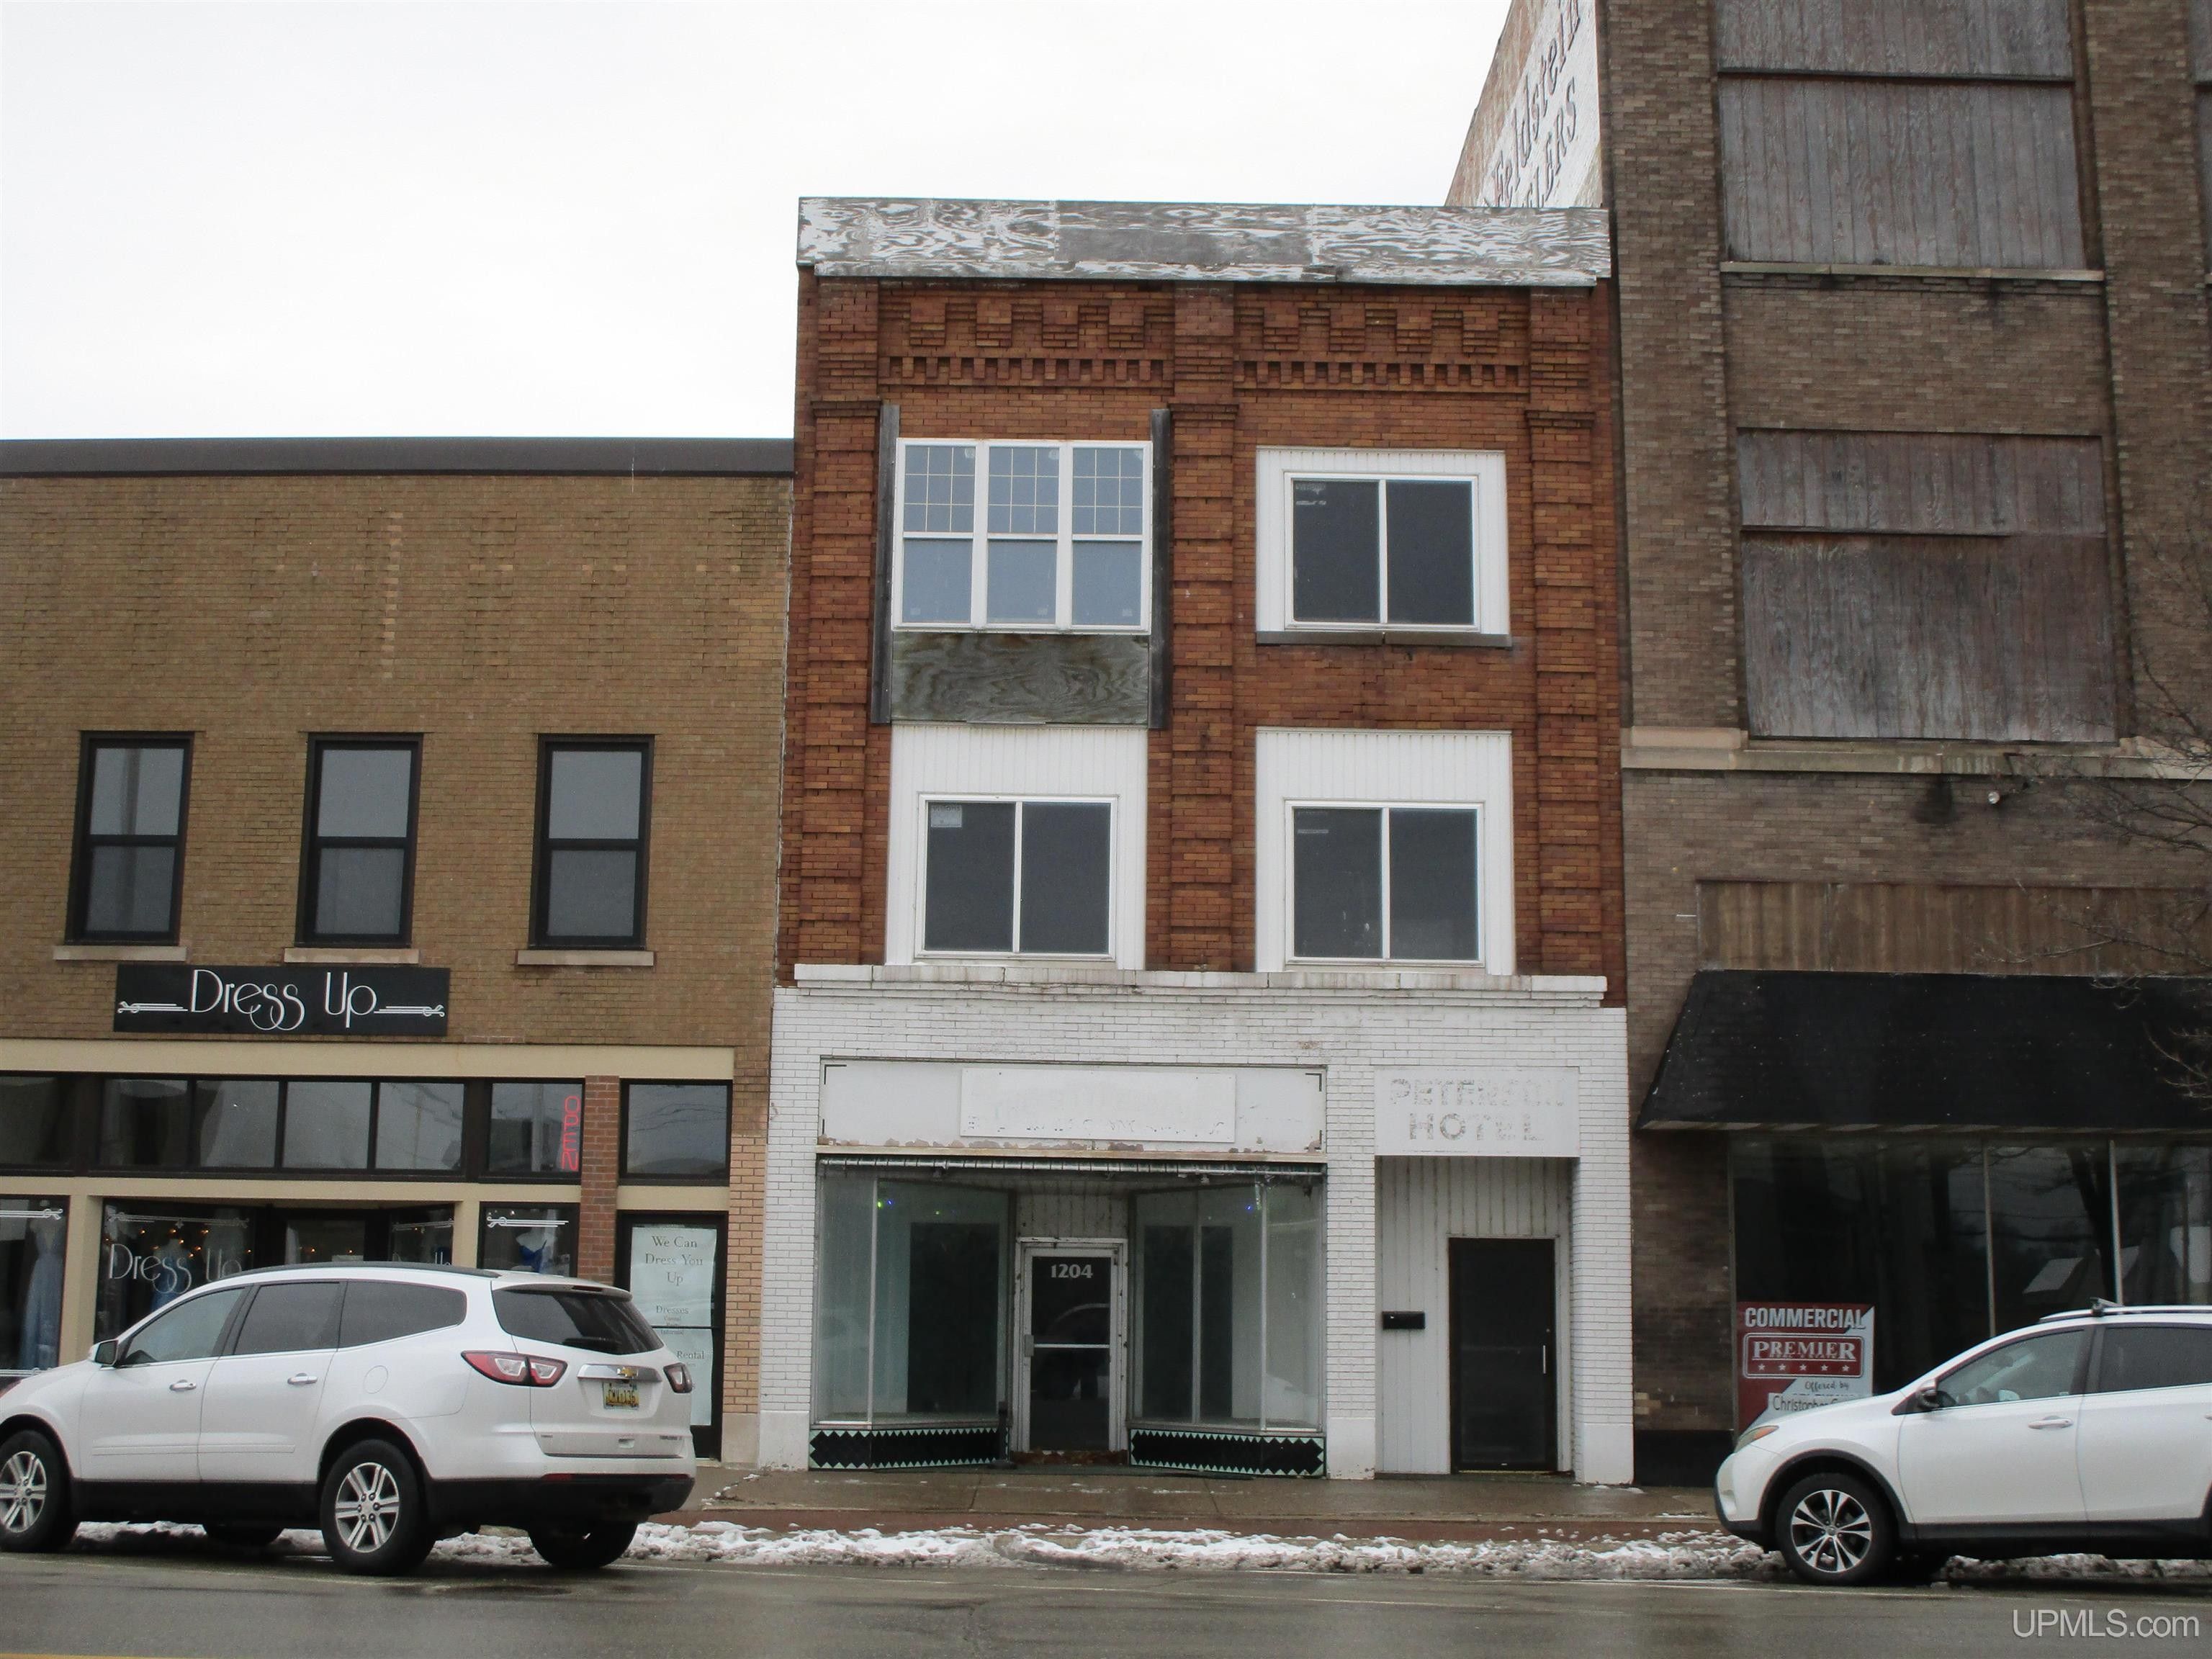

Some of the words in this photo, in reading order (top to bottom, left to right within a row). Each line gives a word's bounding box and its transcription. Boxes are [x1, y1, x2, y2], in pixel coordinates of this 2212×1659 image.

[191, 969, 305, 1030] Dress
[325, 972, 377, 1028] Up
[560, 1095, 581, 1172] OPEN
[1408, 1112, 1545, 1141] HOTEL
[652, 1236, 670, 1247] We
[674, 1236, 698, 1248] Can
[645, 1254, 676, 1265] Dress
[681, 1254, 703, 1266] You
[109, 1244, 192, 1294] Dress
[1051, 1264, 1093, 1278] 1204
[667, 1272, 683, 1286] Up
[656, 1305, 689, 1314] Dresses
[1745, 1307, 1866, 1330] COMMERCIAL
[677, 1351, 704, 1359] Rental
[1752, 1341, 1856, 1359] PREMIER
[1804, 1381, 1835, 1392] Offered
